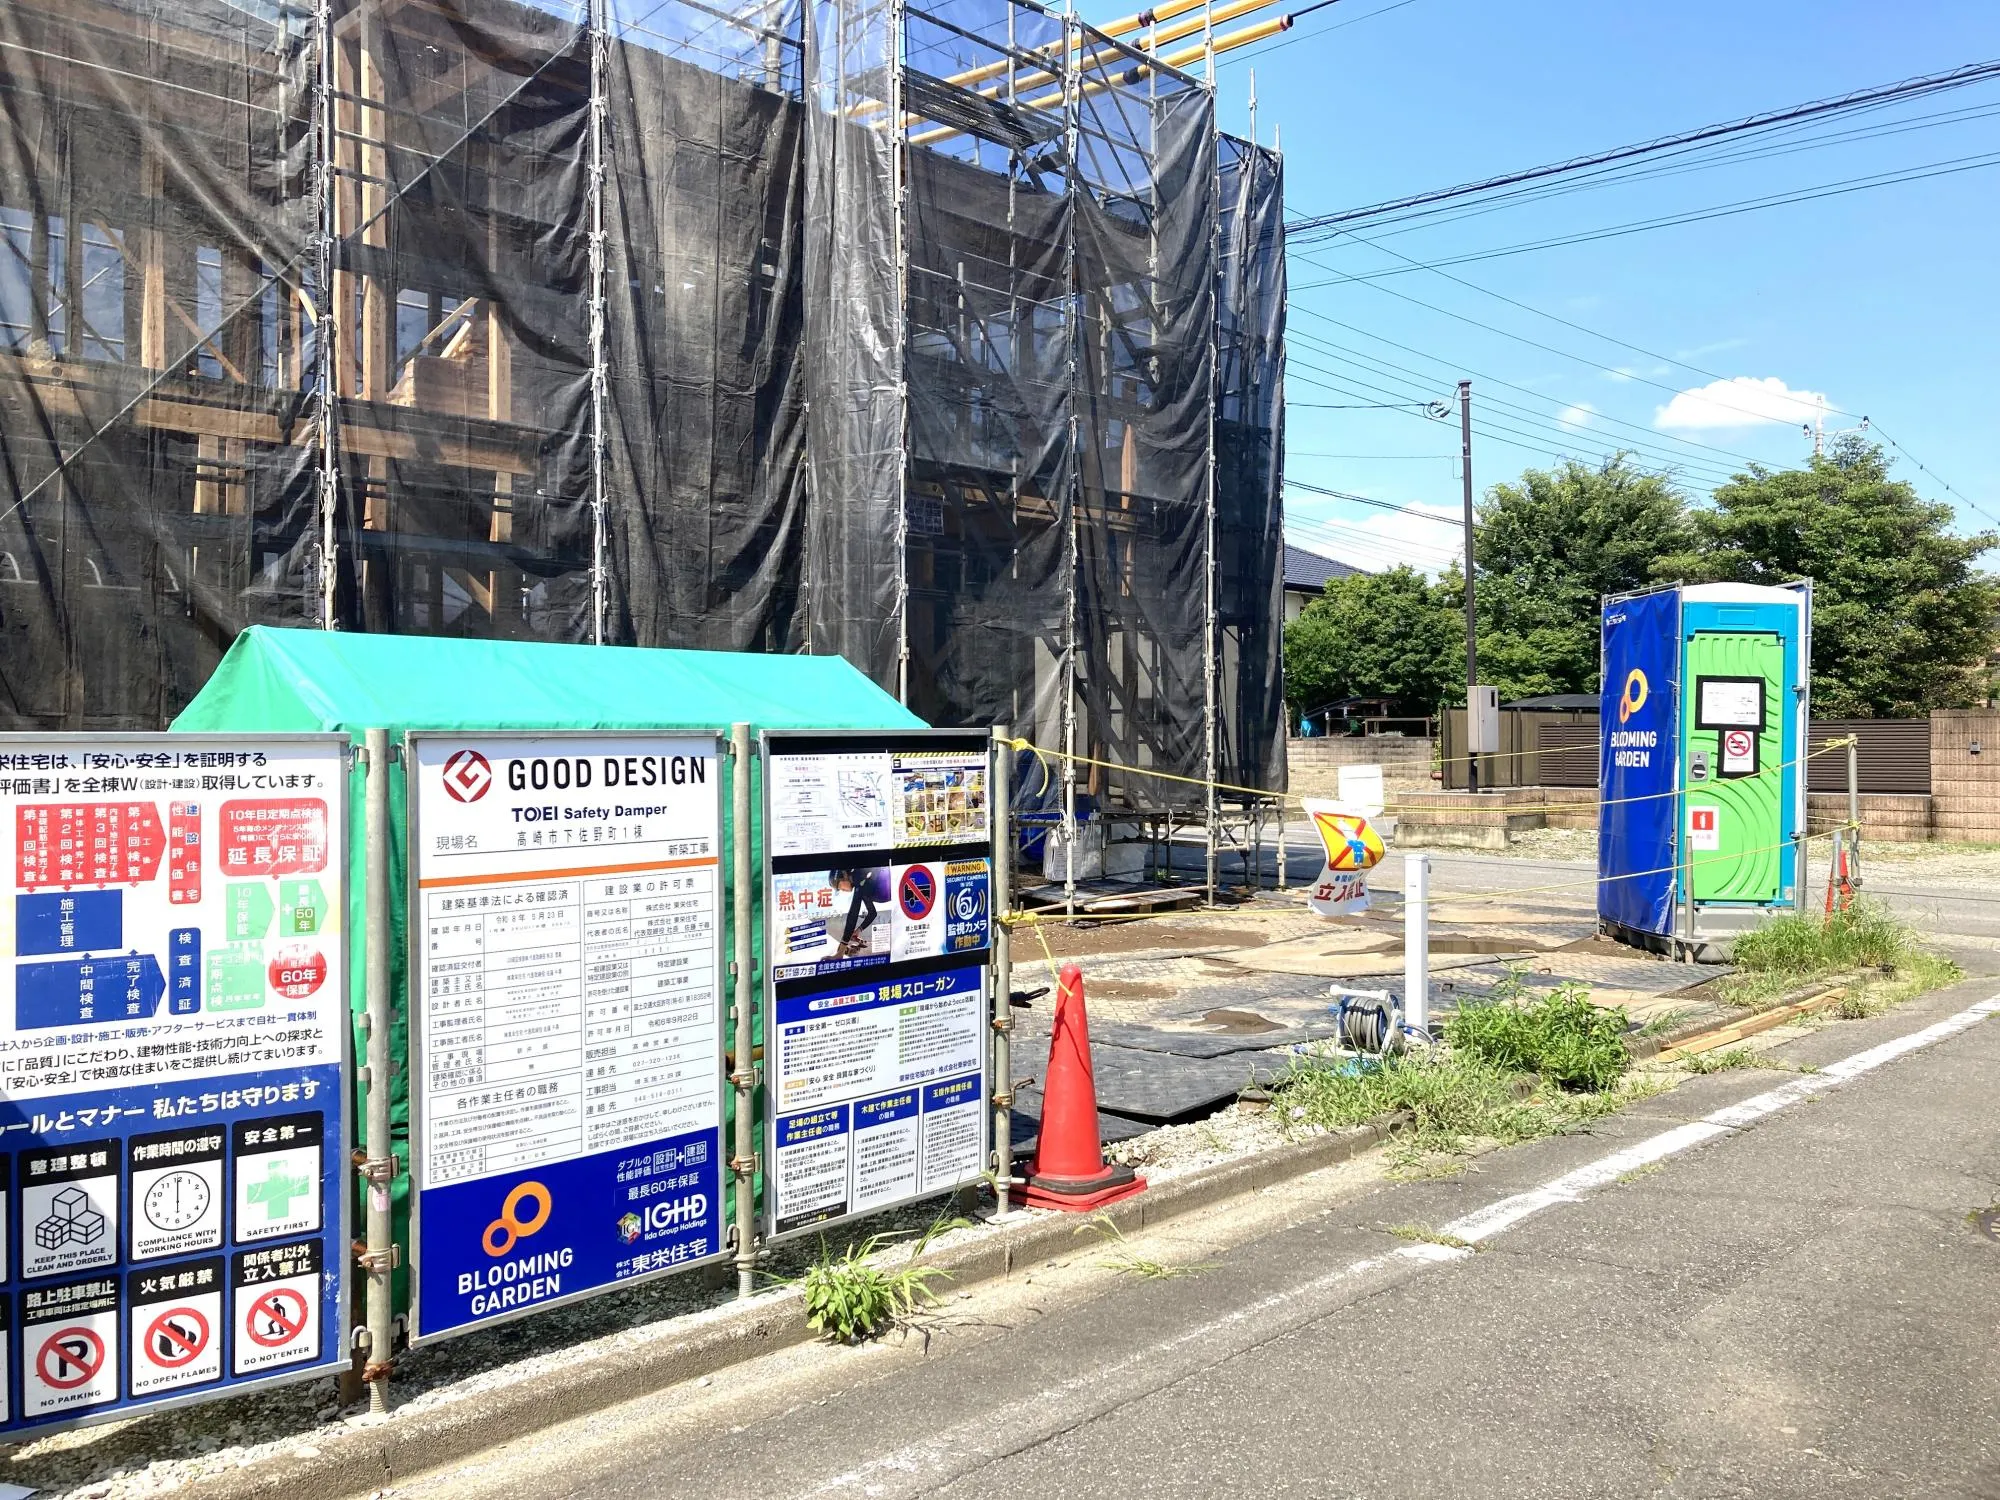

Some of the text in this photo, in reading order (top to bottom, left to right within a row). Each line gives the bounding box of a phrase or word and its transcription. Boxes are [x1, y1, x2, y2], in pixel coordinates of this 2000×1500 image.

[1611, 731, 1656, 747] BLOOMING
[1615, 751, 1649, 767] GARDEN
[508, 756, 705, 791] GOOD DESIGN
[564, 806, 610, 820] Safety
[614, 805, 667, 817] Damper
[436, 835, 478, 849] 現場名
[668, 842, 709, 856] 新築工事
[227, 845, 321, 865] 延長保証
[951, 863, 981, 873] WARNING
[441, 889, 568, 911] 建築基準法による確認済
[778, 887, 833, 911] 熱中症
[60, 899, 74, 947] 施工管理
[947, 919, 987, 936] 監視カメラ
[178, 932, 192, 1010] 検査済証
[281, 969, 317, 983] 60年
[792, 967, 815, 977] 協力会
[80, 965, 93, 1019] 中間検査
[127, 961, 141, 1014] 完了検査
[878, 977, 956, 1001] 現場スローガン
[586, 1046, 616, 1059] 販売担当
[586, 1065, 616, 1078] 連絡先
[457, 1082, 558, 1110] 各作業主任者の職務
[586, 1083, 616, 1097] 工事担当
[0, 1080, 320, 1136] ールとマナー 私たちは守ります
[586, 1101, 616, 1115] 連絡先
[245, 1126, 312, 1145] 安全第一
[30, 1151, 107, 1175] 整理整頓
[617, 1155, 652, 1172] ダブルの
[655, 1152, 675, 1166] 設計
[616, 1166, 652, 1183] 性能評価
[627, 1172, 700, 1201] 最長60年保証
[247, 1220, 309, 1237] SAFETY FIRST
[658, 1226, 679, 1237] Group
[680, 1218, 707, 1231] Holdings
[138, 1229, 217, 1247] COMPLIANCE WITH
[141, 1237, 213, 1254] WORKING HOURS
[27, 1254, 113, 1273] CLEAN AND ORDERLY
[35, 1247, 105, 1264] KEEP THIS PLACE
[243, 1243, 311, 1268] 関係者以外
[632, 1238, 707, 1274] 東栄住宅
[140, 1268, 213, 1294] 火気厳禁
[243, 1259, 311, 1283] 立入禁止
[458, 1247, 573, 1295] BLOOMING
[26, 1280, 115, 1308] 路上駐車禁止
[471, 1273, 560, 1315] GARDEN
[244, 1346, 310, 1366] DO NOT ENTER
[136, 1366, 217, 1388] NO OPEN FLAMES
[58, 1390, 101, 1403] PARKING
